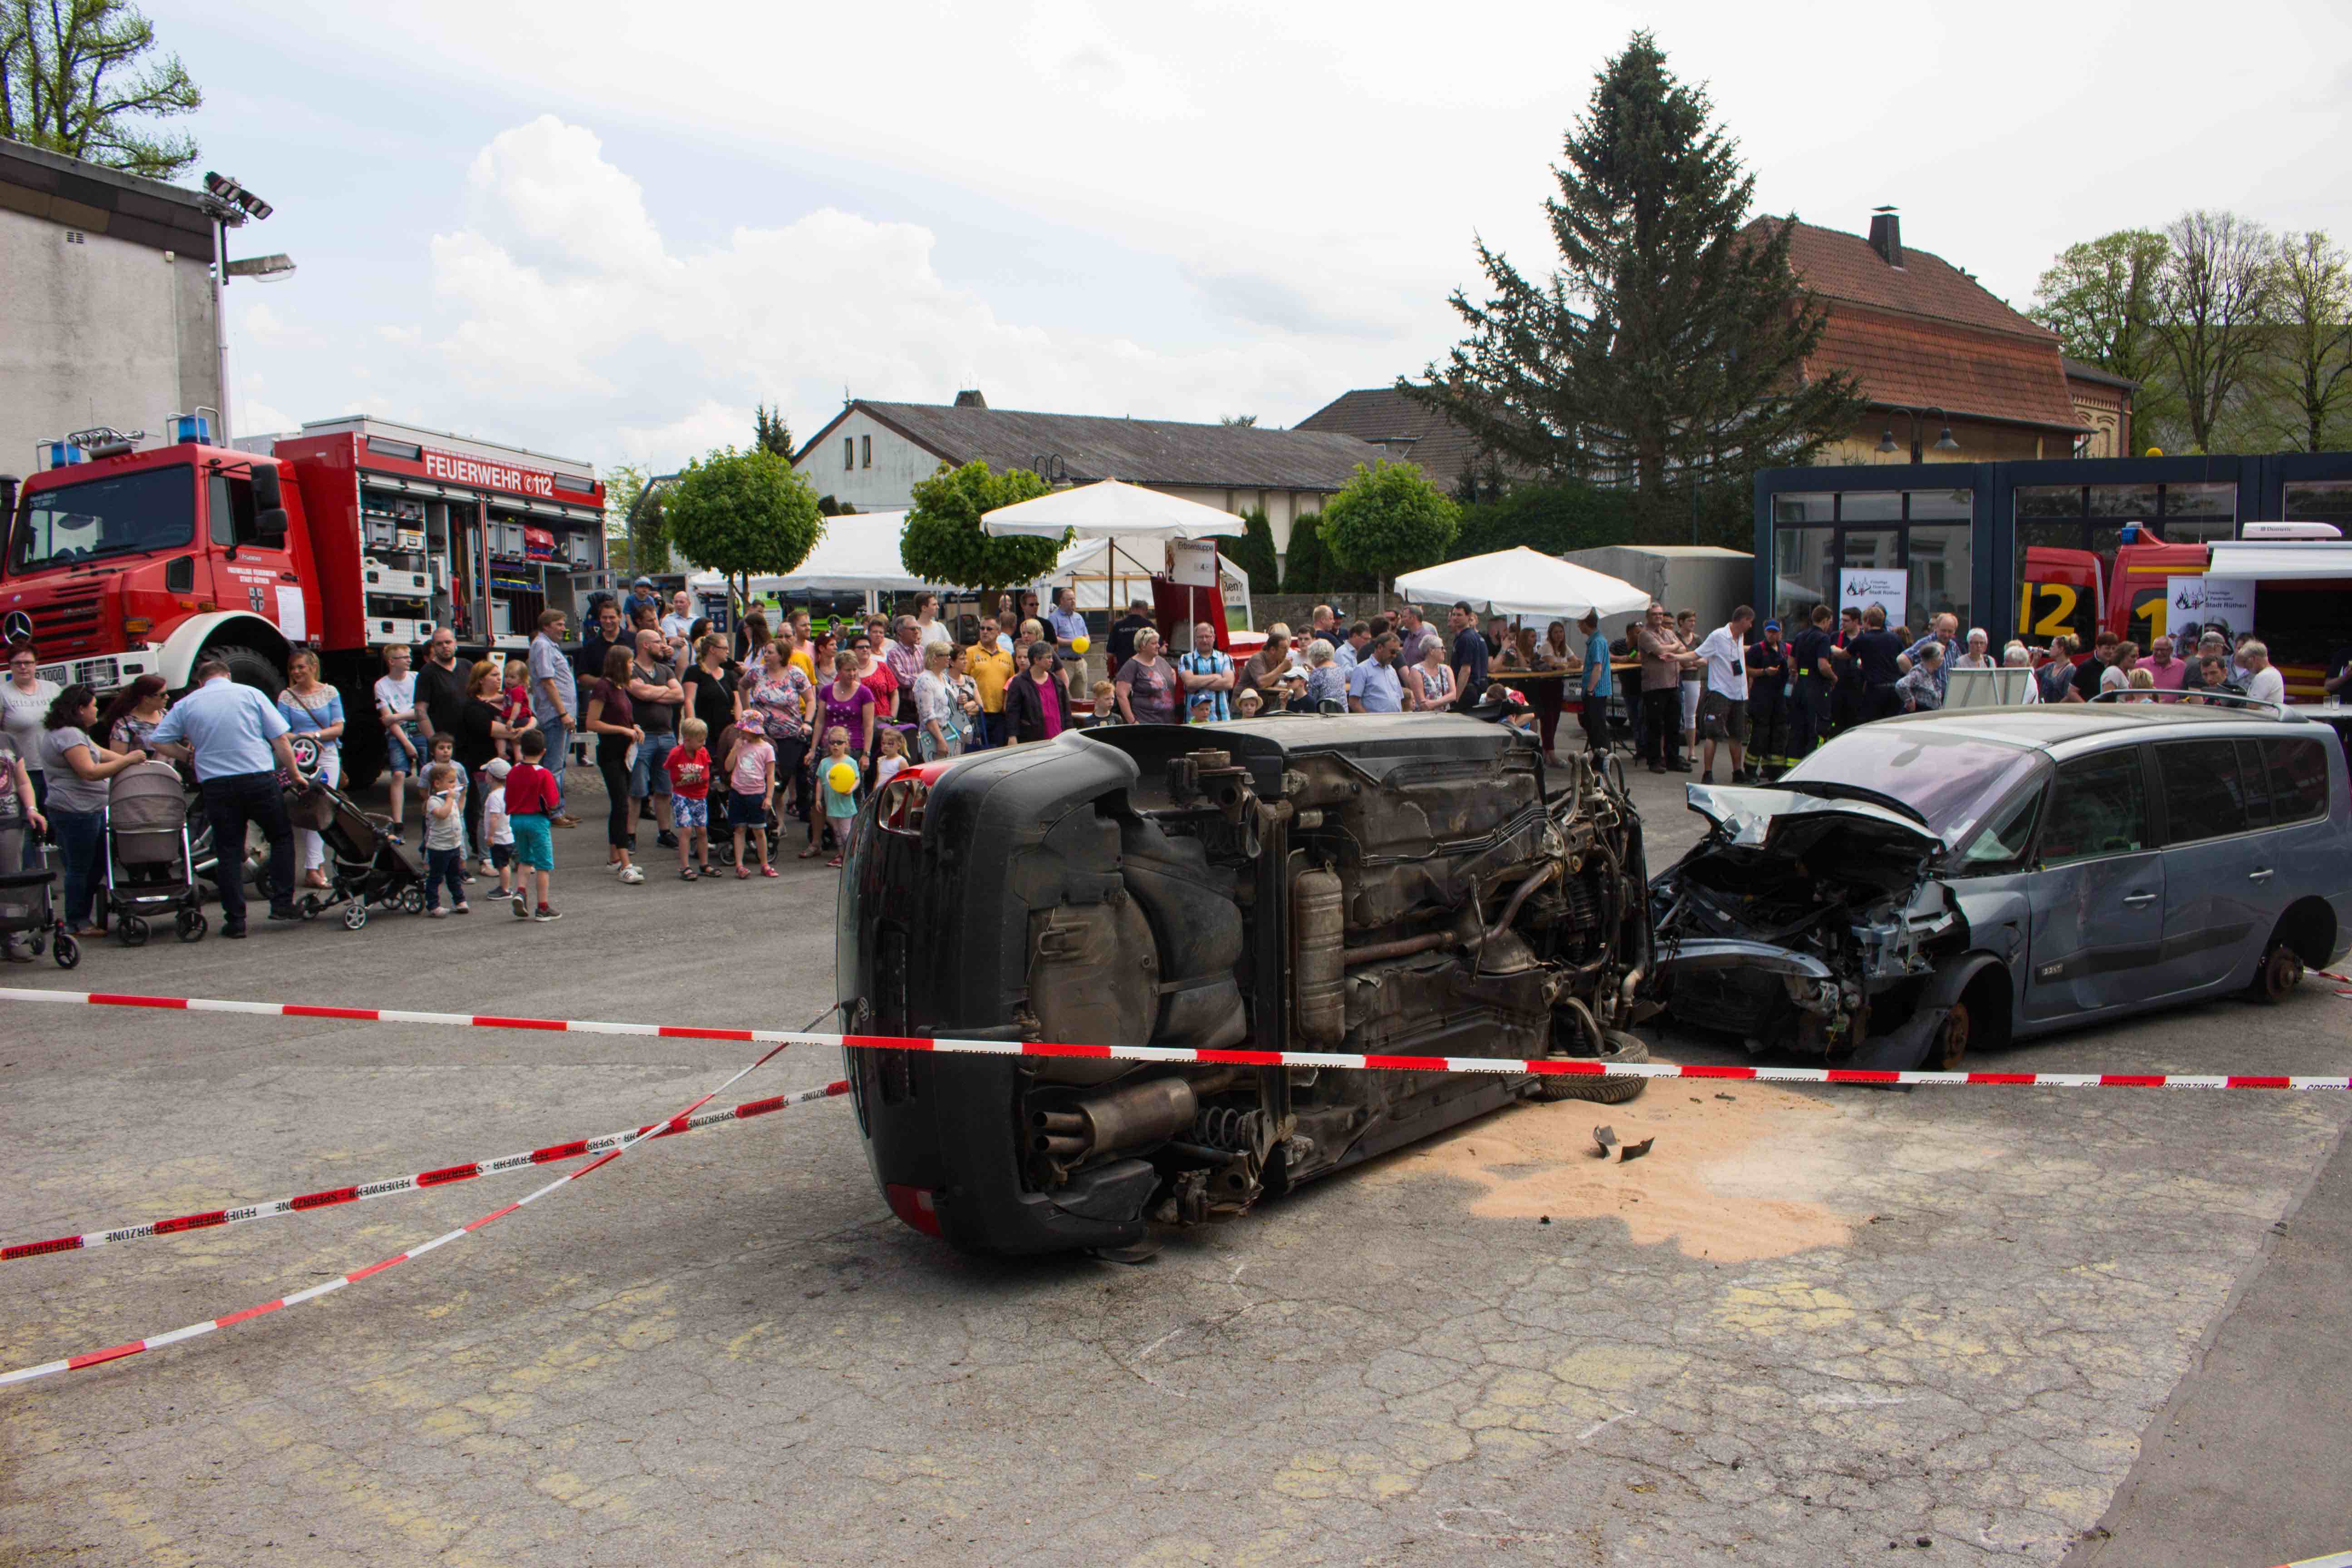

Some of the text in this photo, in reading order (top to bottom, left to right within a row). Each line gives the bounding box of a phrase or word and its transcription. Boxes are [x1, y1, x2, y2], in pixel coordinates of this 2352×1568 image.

[426, 454, 553, 496] FEUERWEHR 112
[1177, 541, 1214, 554] Erbsensuppe
[43, 669, 63, 681] 1000
[688, 1110, 735, 1128] SPERRZONE
[564, 1137, 616, 1155] SPERRZONE
[493, 1152, 549, 1170] FEUERWEHR
[426, 1165, 484, 1184] SPERRZONE
[348, 1179, 411, 1198] FEUERWEHR
[275, 1192, 338, 1213] SPERRZONE
[188, 1207, 258, 1227] FEUERWEHR
[105, 1221, 175, 1243] SPERRZONE
[6, 1237, 85, 1259] FEUERWEHR
